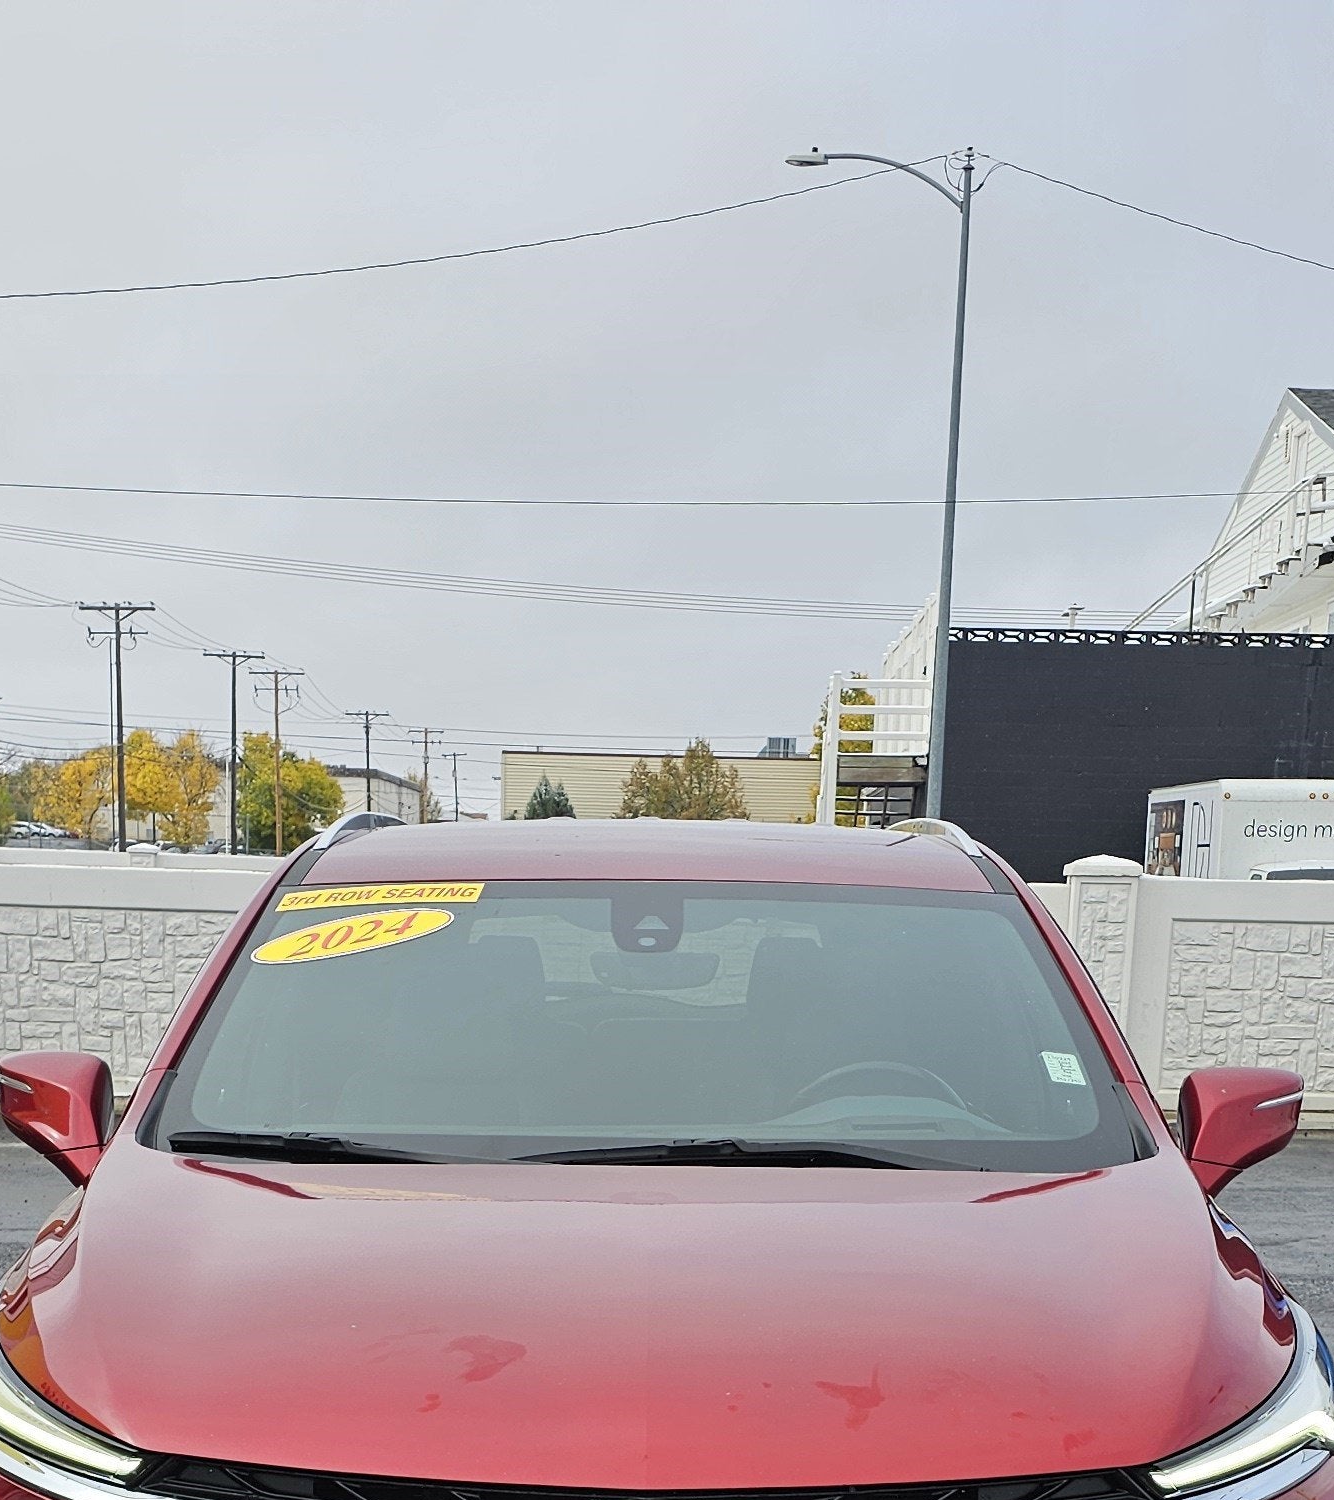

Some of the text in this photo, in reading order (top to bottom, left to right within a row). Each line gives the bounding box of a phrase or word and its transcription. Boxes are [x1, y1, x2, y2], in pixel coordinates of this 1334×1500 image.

[1243, 818, 1308, 843] design
[281, 886, 478, 907] 3rd ROW SEATING
[285, 911, 420, 959] 2024
